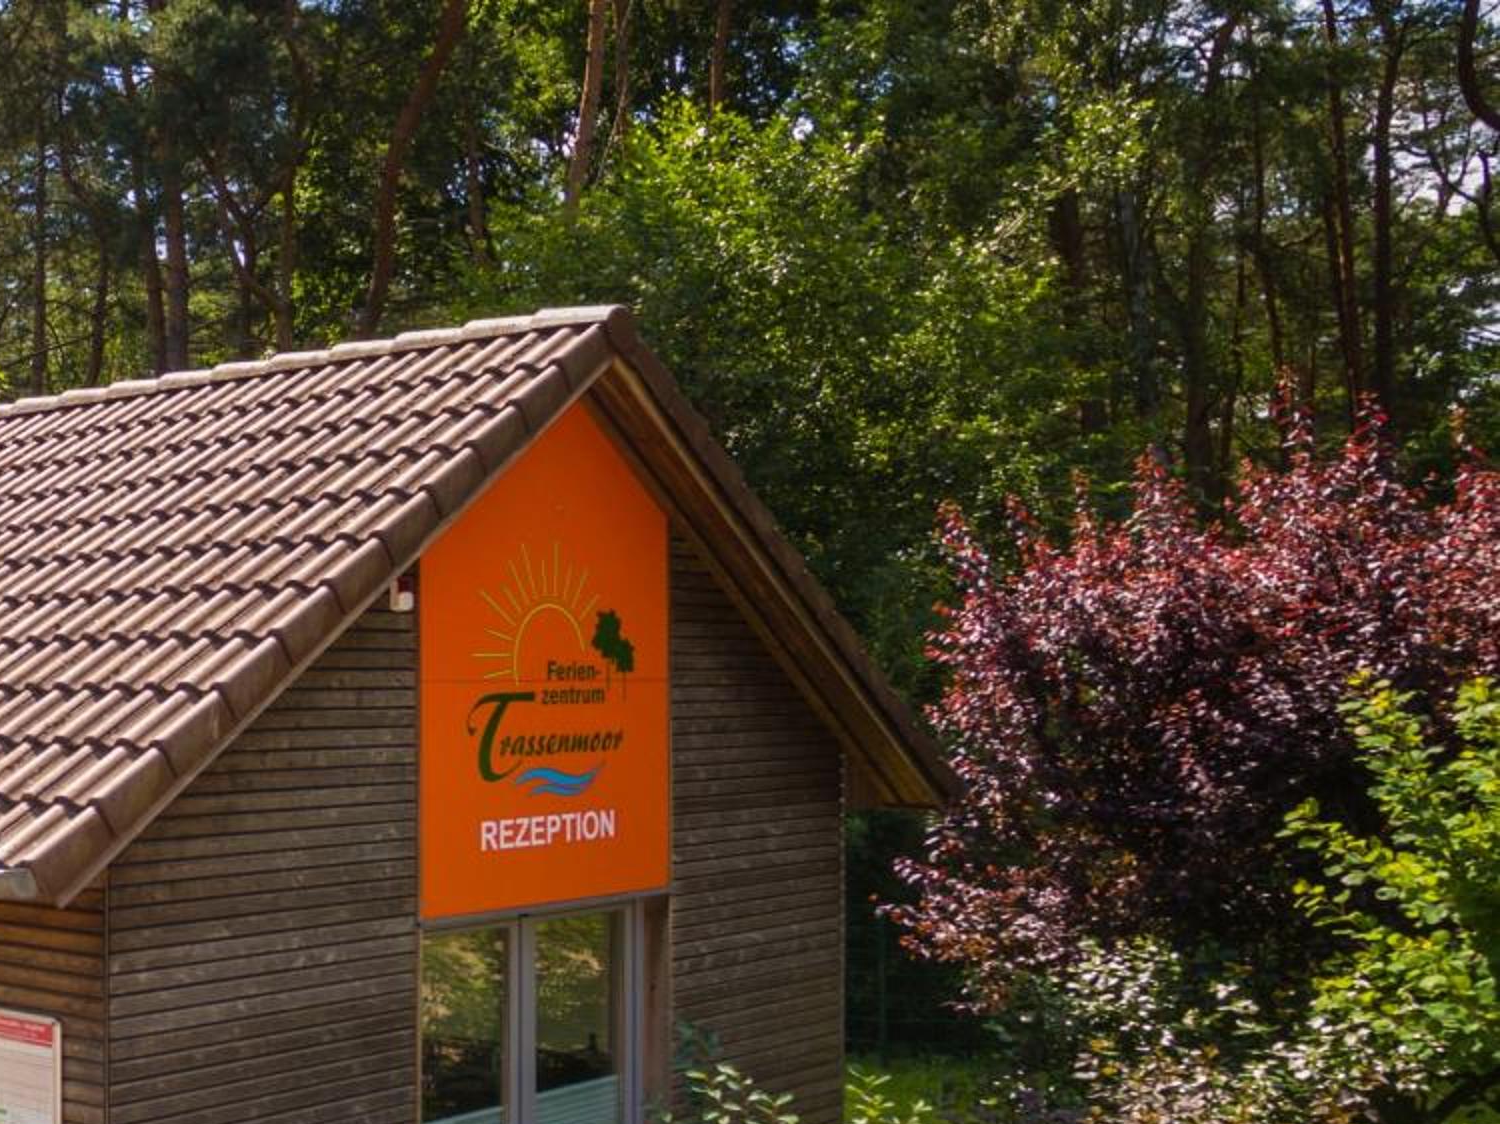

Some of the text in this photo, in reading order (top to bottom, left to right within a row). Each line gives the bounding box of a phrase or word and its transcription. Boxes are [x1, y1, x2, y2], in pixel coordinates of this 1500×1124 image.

[547, 660, 601, 680] Ferien-
[541, 687, 605, 704] zentrum
[468, 692, 623, 782] Trassenmoor
[480, 809, 616, 851] REZEPTION
